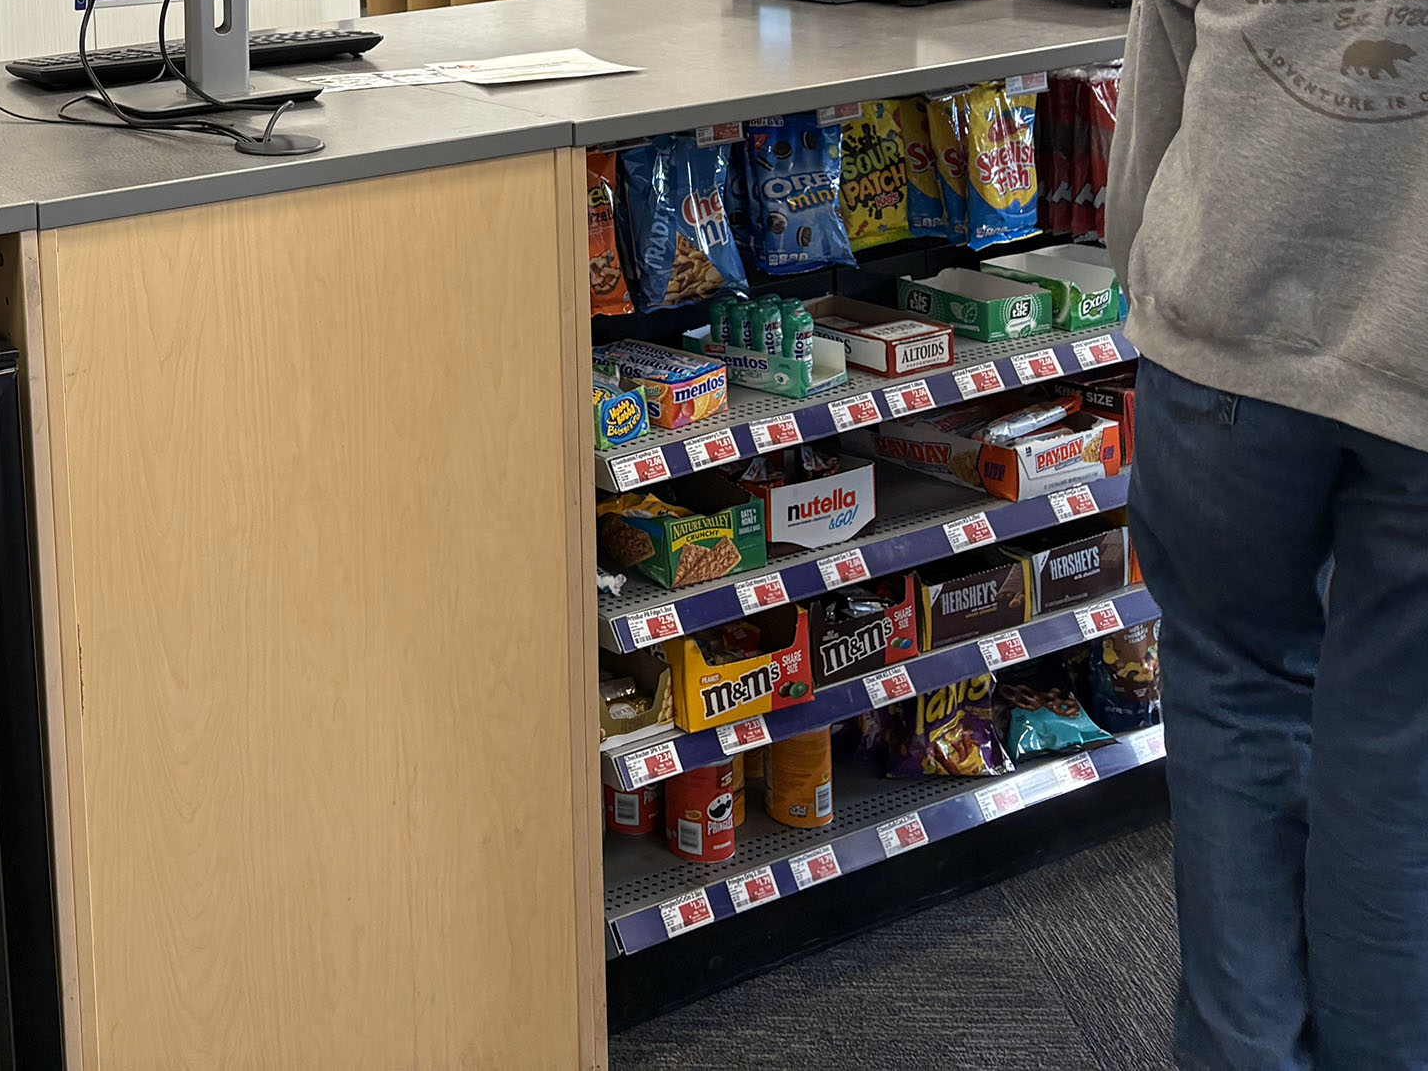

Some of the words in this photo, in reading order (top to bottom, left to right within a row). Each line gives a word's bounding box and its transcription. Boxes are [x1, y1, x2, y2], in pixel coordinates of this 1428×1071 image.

[841, 139, 899, 180] SOUR
[841, 162, 907, 211] PATCH
[1011, 307, 1030, 318] tac
[1014, 299, 1029, 312] tic
[1081, 291, 1111, 315] Extra
[901, 341, 945, 364] ALTOIDS
[674, 375, 725, 404] mentos
[1086, 391, 1114, 407] SIZE
[875, 436, 951, 464] PAYDAY
[1037, 437, 1083, 471] PAYDAY
[787, 488, 856, 521] nutella
[672, 519, 702, 540] NATURE
[702, 512, 731, 531] VALLEY
[685, 530, 719, 543] CRUNCHY
[1050, 545, 1100, 580] HERSHEY'S
[941, 580, 998, 615] HERSHEY'S
[894, 606, 913, 622] SHARE
[898, 620, 910, 630] SIZE
[782, 650, 802, 667] SHARE
[787, 665, 798, 675] SIZE
